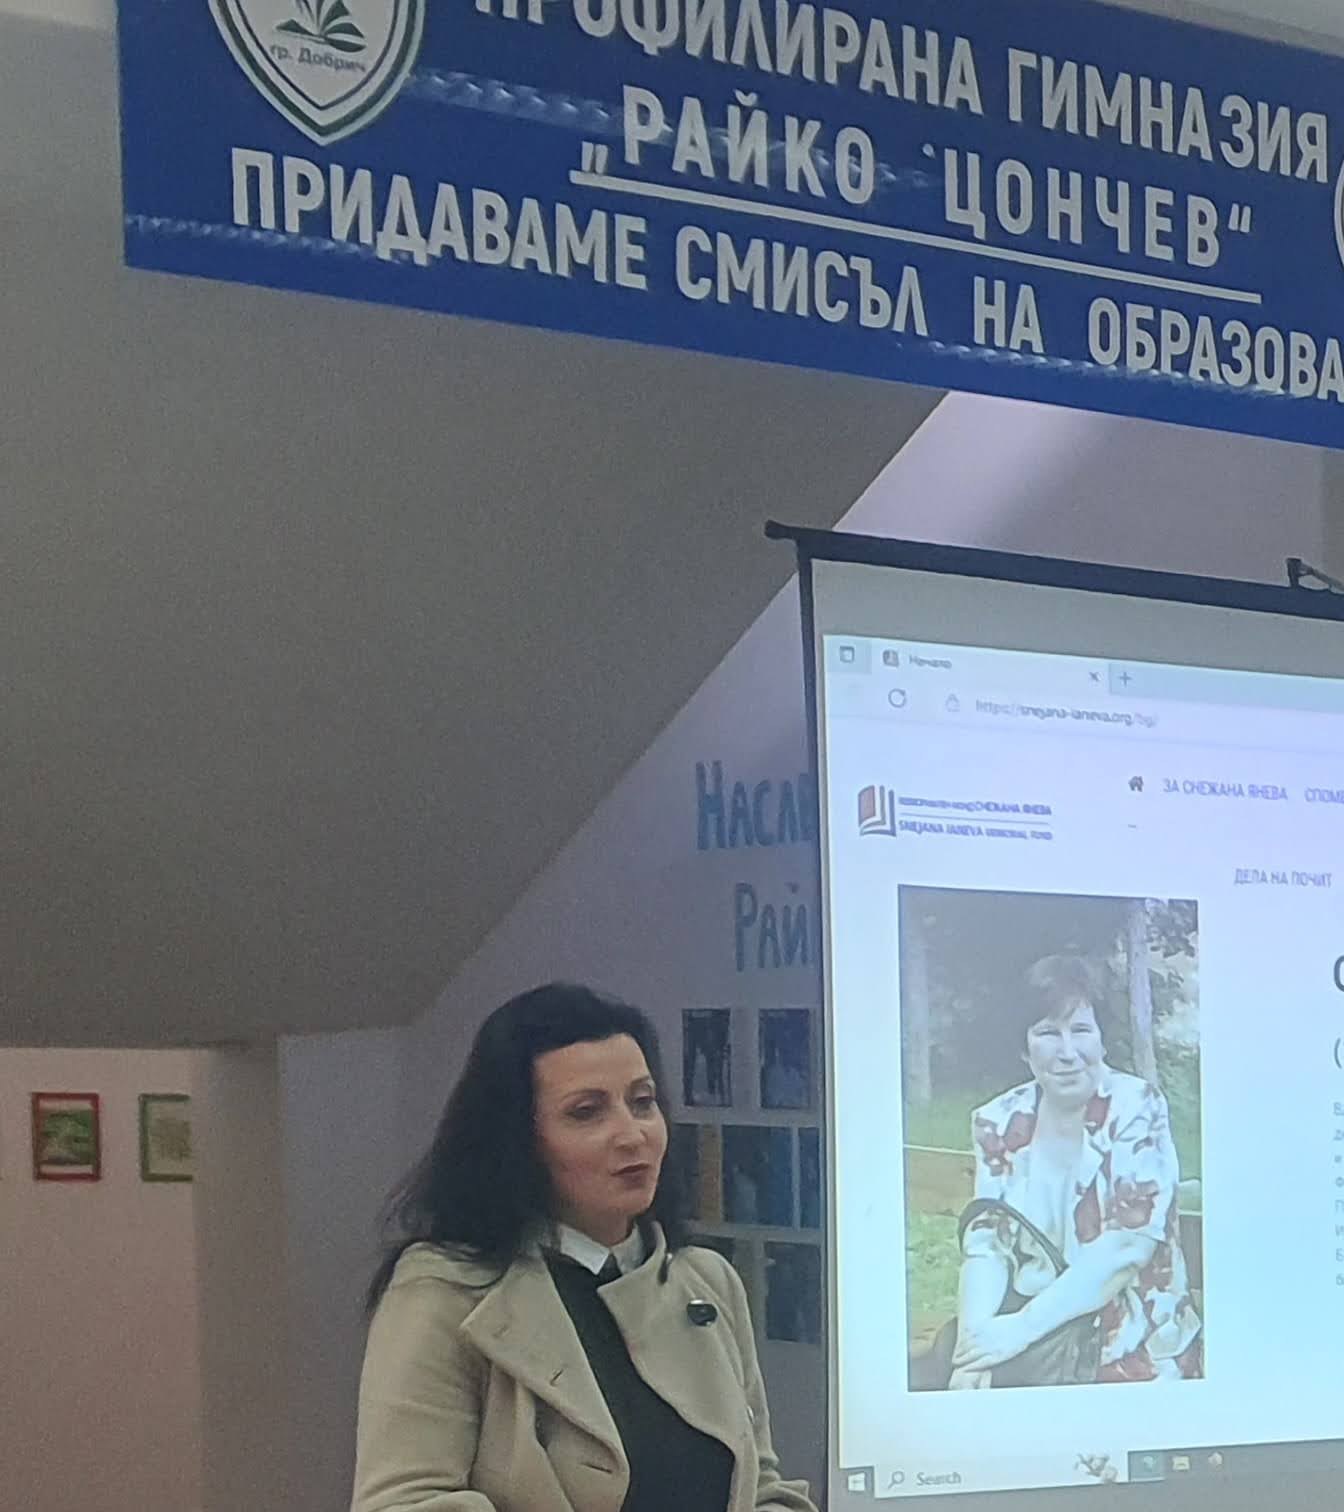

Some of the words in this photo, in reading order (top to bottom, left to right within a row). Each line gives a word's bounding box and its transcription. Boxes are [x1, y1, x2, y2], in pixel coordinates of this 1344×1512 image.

[298, 46, 367, 73] Добрич
[473, 0, 983, 115] ОФИЛИРАНА
[1006, 48, 1329, 183] ГИМНАЗИЯ
[578, 85, 876, 204] „РАЙКО
[942, 146, 1252, 268] ЦОНЧЕВ“
[231, 147, 649, 291] ПРИДАВАМЕ
[675, 226, 929, 337] СМИСЪЛ
[972, 275, 1044, 355] НА
[1162, 777, 1180, 793] ЗА
[1182, 779, 1245, 798] СНЕЖАНА
[1248, 783, 1288, 801] ЯНЕВА
[1234, 868, 1267, 886] ДЕЛА
[1270, 870, 1288, 886] НА
[1290, 871, 1332, 888] ПОЧИТ
[916, 1471, 961, 1486] Search
